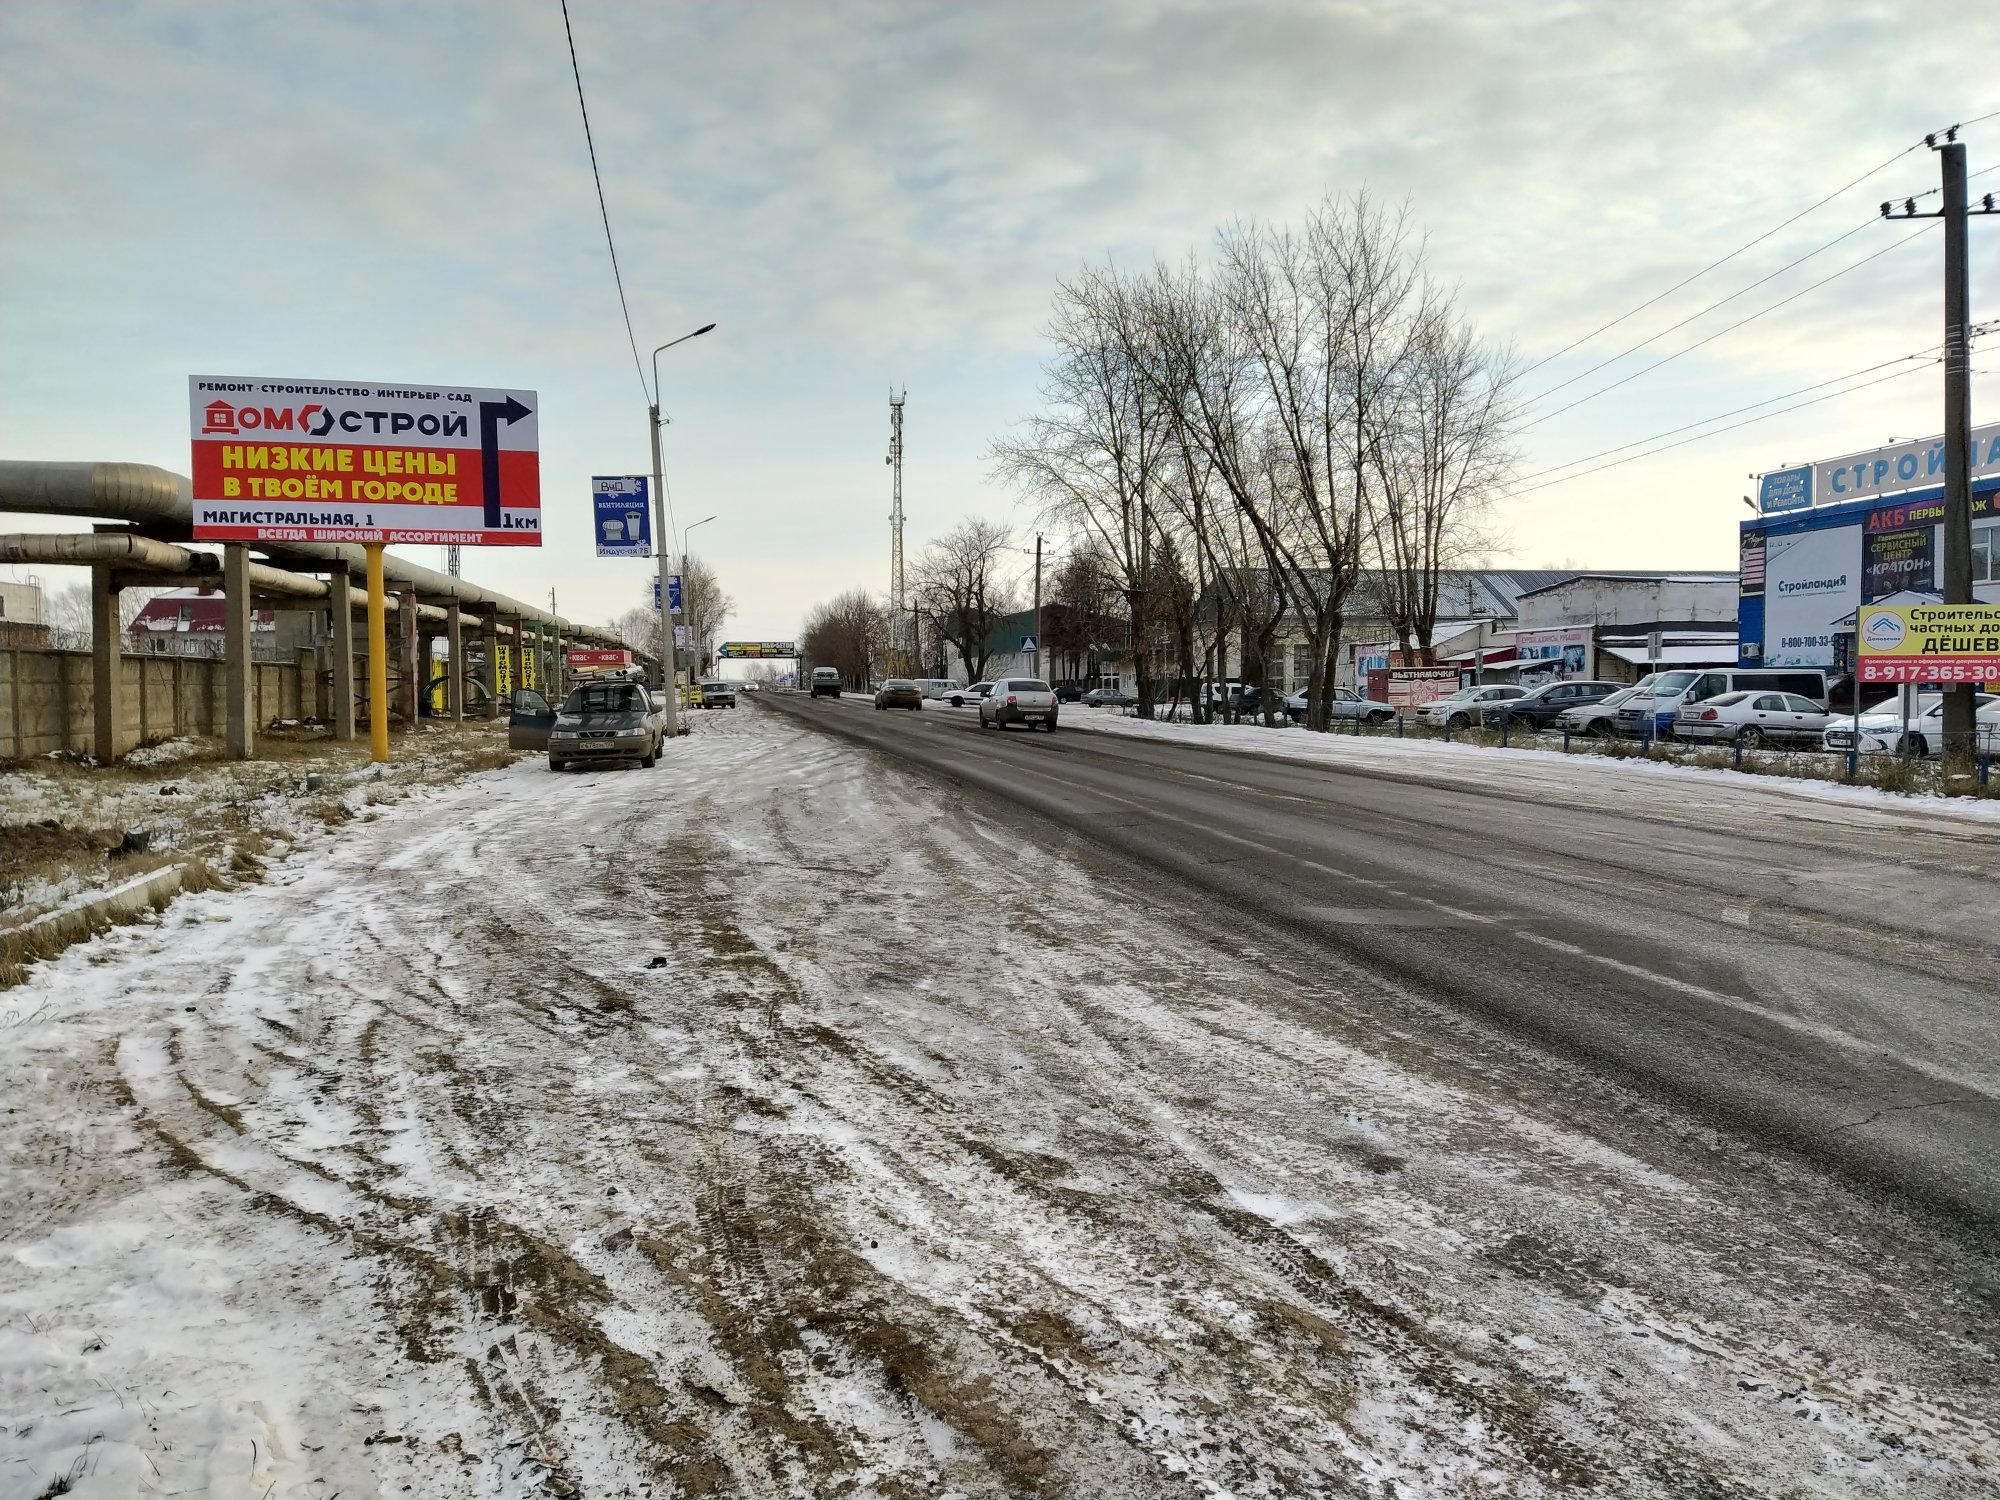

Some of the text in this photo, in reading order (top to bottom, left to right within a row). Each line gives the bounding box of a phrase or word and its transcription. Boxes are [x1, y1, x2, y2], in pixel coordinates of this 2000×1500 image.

[198, 382, 472, 403] РЕМОНТ СТРОИТЕЛЬСТВО ИНТЕРЬЕР САД
[222, 445, 456, 476] НИЗКИЕ ЦЕНЫ
[1773, 473, 1801, 484] ТОВАРЫ
[223, 474, 458, 504] В ТВОЁМ ГОРОДЕ
[1768, 485, 1804, 498] ДЛЯ ДОМА
[598, 501, 645, 509] ВЕНТИЛЯЦИЯ
[1773, 496, 1805, 507] РЕМОНТА
[203, 510, 374, 527] МАГИСТРАЛЬНАЯ, 1
[1869, 508, 1905, 530] АКБ
[1908, 506, 1945, 521] ПЕРВЫ
[257, 528, 483, 543] ВСЕГДА ШИРОКИЙ АССОРТИМЕНТ
[1870, 534, 1927, 553] СЕРВИСНЫЙ
[1883, 549, 1913, 562] ЦЕНТР
[1866, 558, 1932, 575] «КРАТОН»
[1910, 608, 2000, 622] Строительс
[1909, 623, 2000, 635] частных до
[1921, 635, 1999, 655] ДЁШЕВ
[497, 646, 508, 693] ШИНОМОНТАЖ
[1392, 670, 1454, 679] ВЬЕТНАМОЧКА
